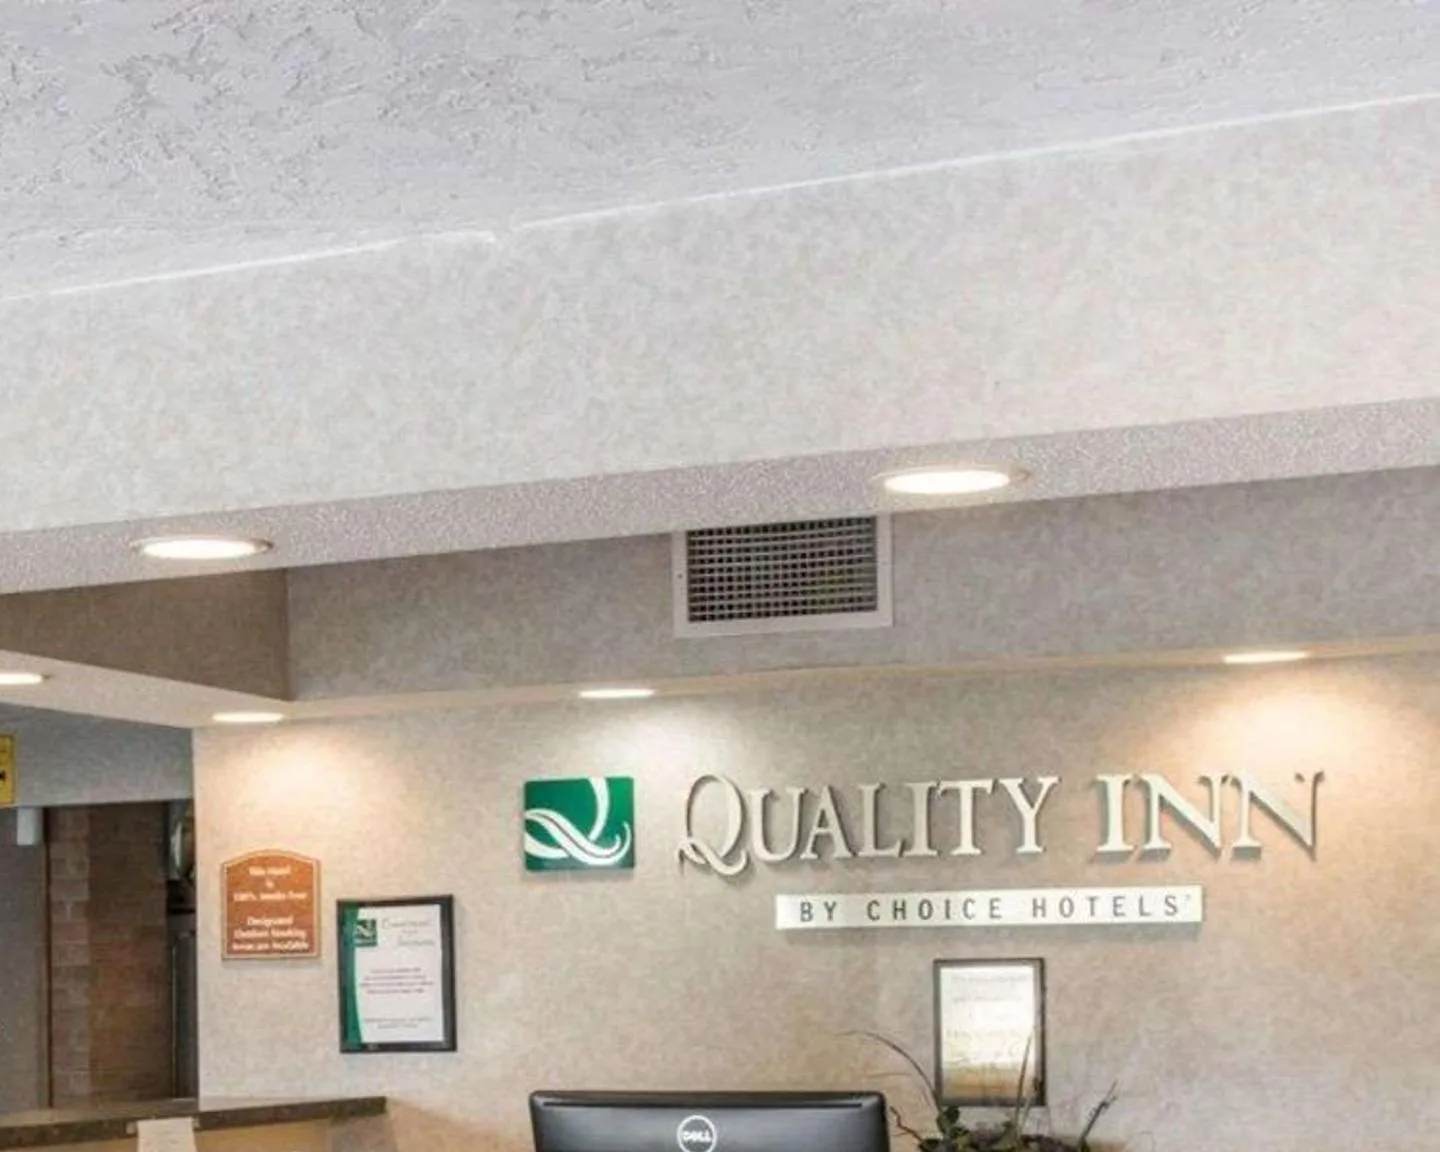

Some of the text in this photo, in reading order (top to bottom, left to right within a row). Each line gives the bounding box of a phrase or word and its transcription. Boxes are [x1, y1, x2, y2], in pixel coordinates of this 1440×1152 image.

[678, 771, 1325, 876] QUALITY INN
[799, 895, 1180, 922] BY CHOICE HOTELS
[683, 1130, 711, 1143] DELL
